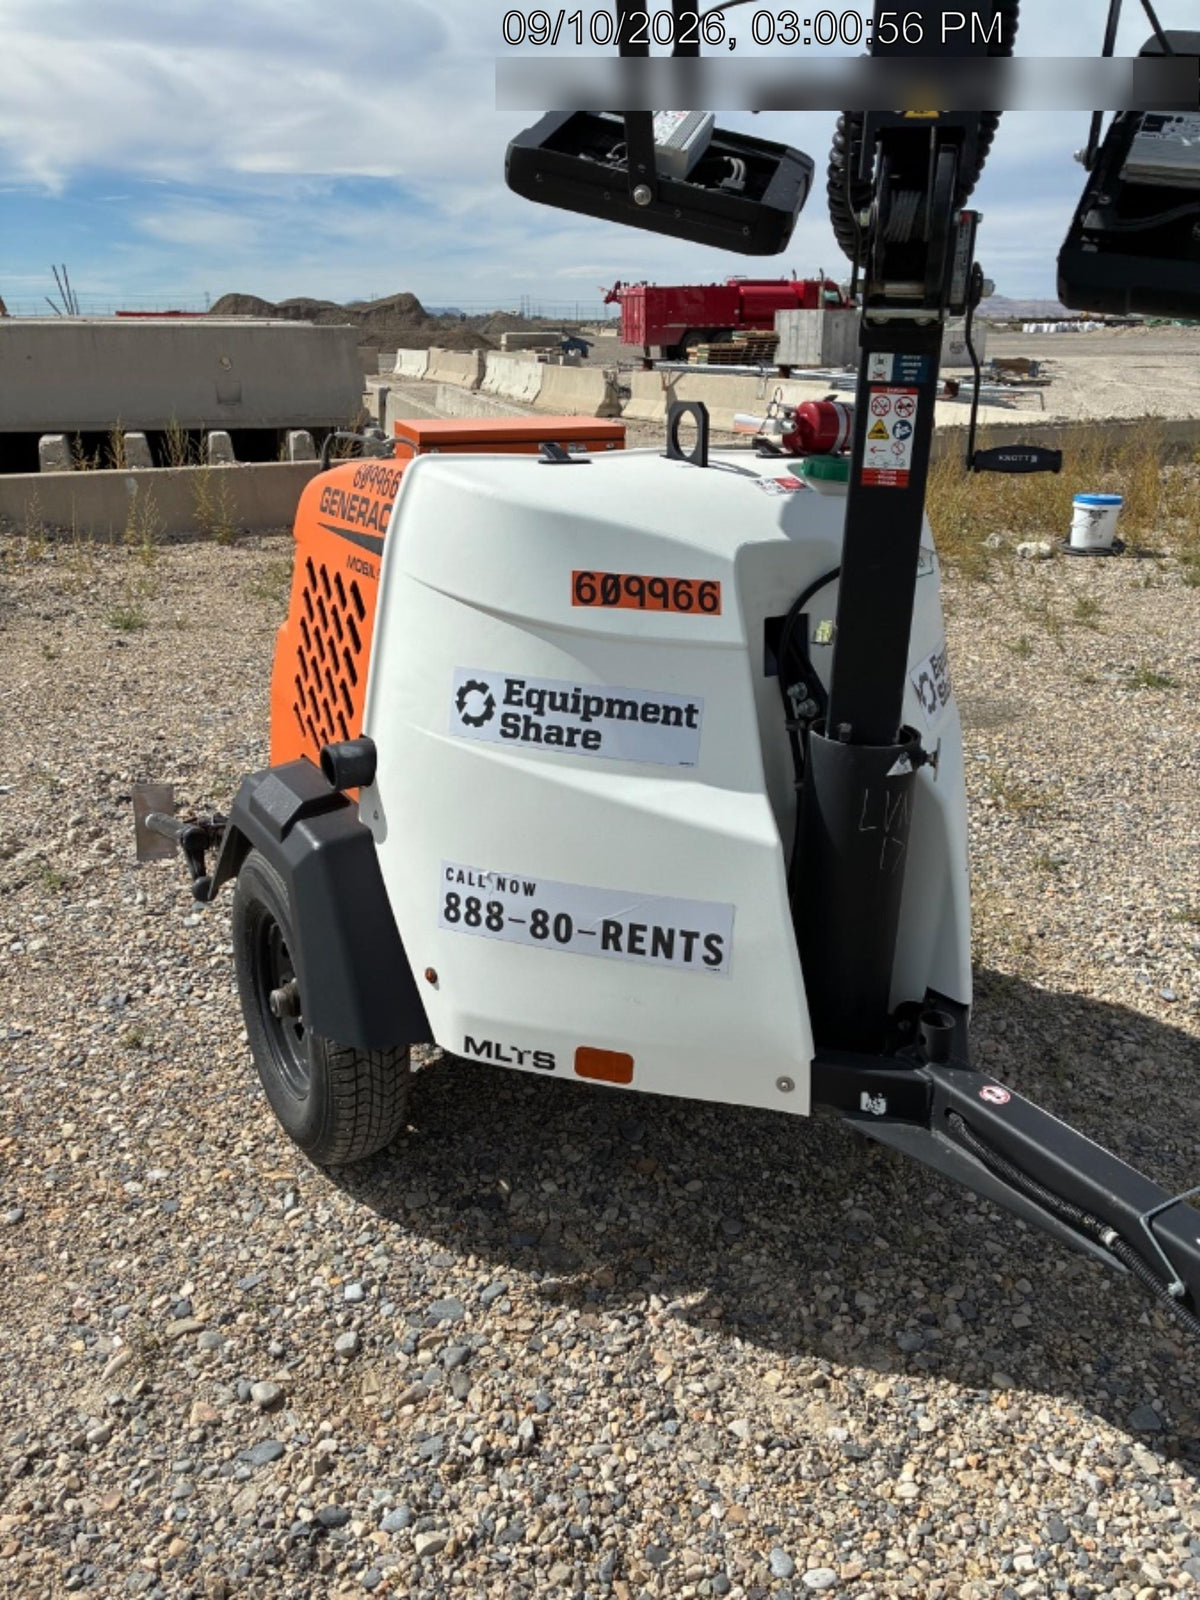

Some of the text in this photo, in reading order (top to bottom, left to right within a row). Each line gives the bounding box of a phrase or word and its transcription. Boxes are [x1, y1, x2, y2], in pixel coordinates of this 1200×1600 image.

[319, 485, 394, 534] GENERAC
[575, 570, 719, 613] 609966
[502, 678, 700, 730] Equipment
[499, 711, 603, 751] Share
[445, 866, 538, 898] CALL NOW
[443, 891, 724, 967] 888-80-RENTS
[463, 1034, 556, 1071] MLTS
